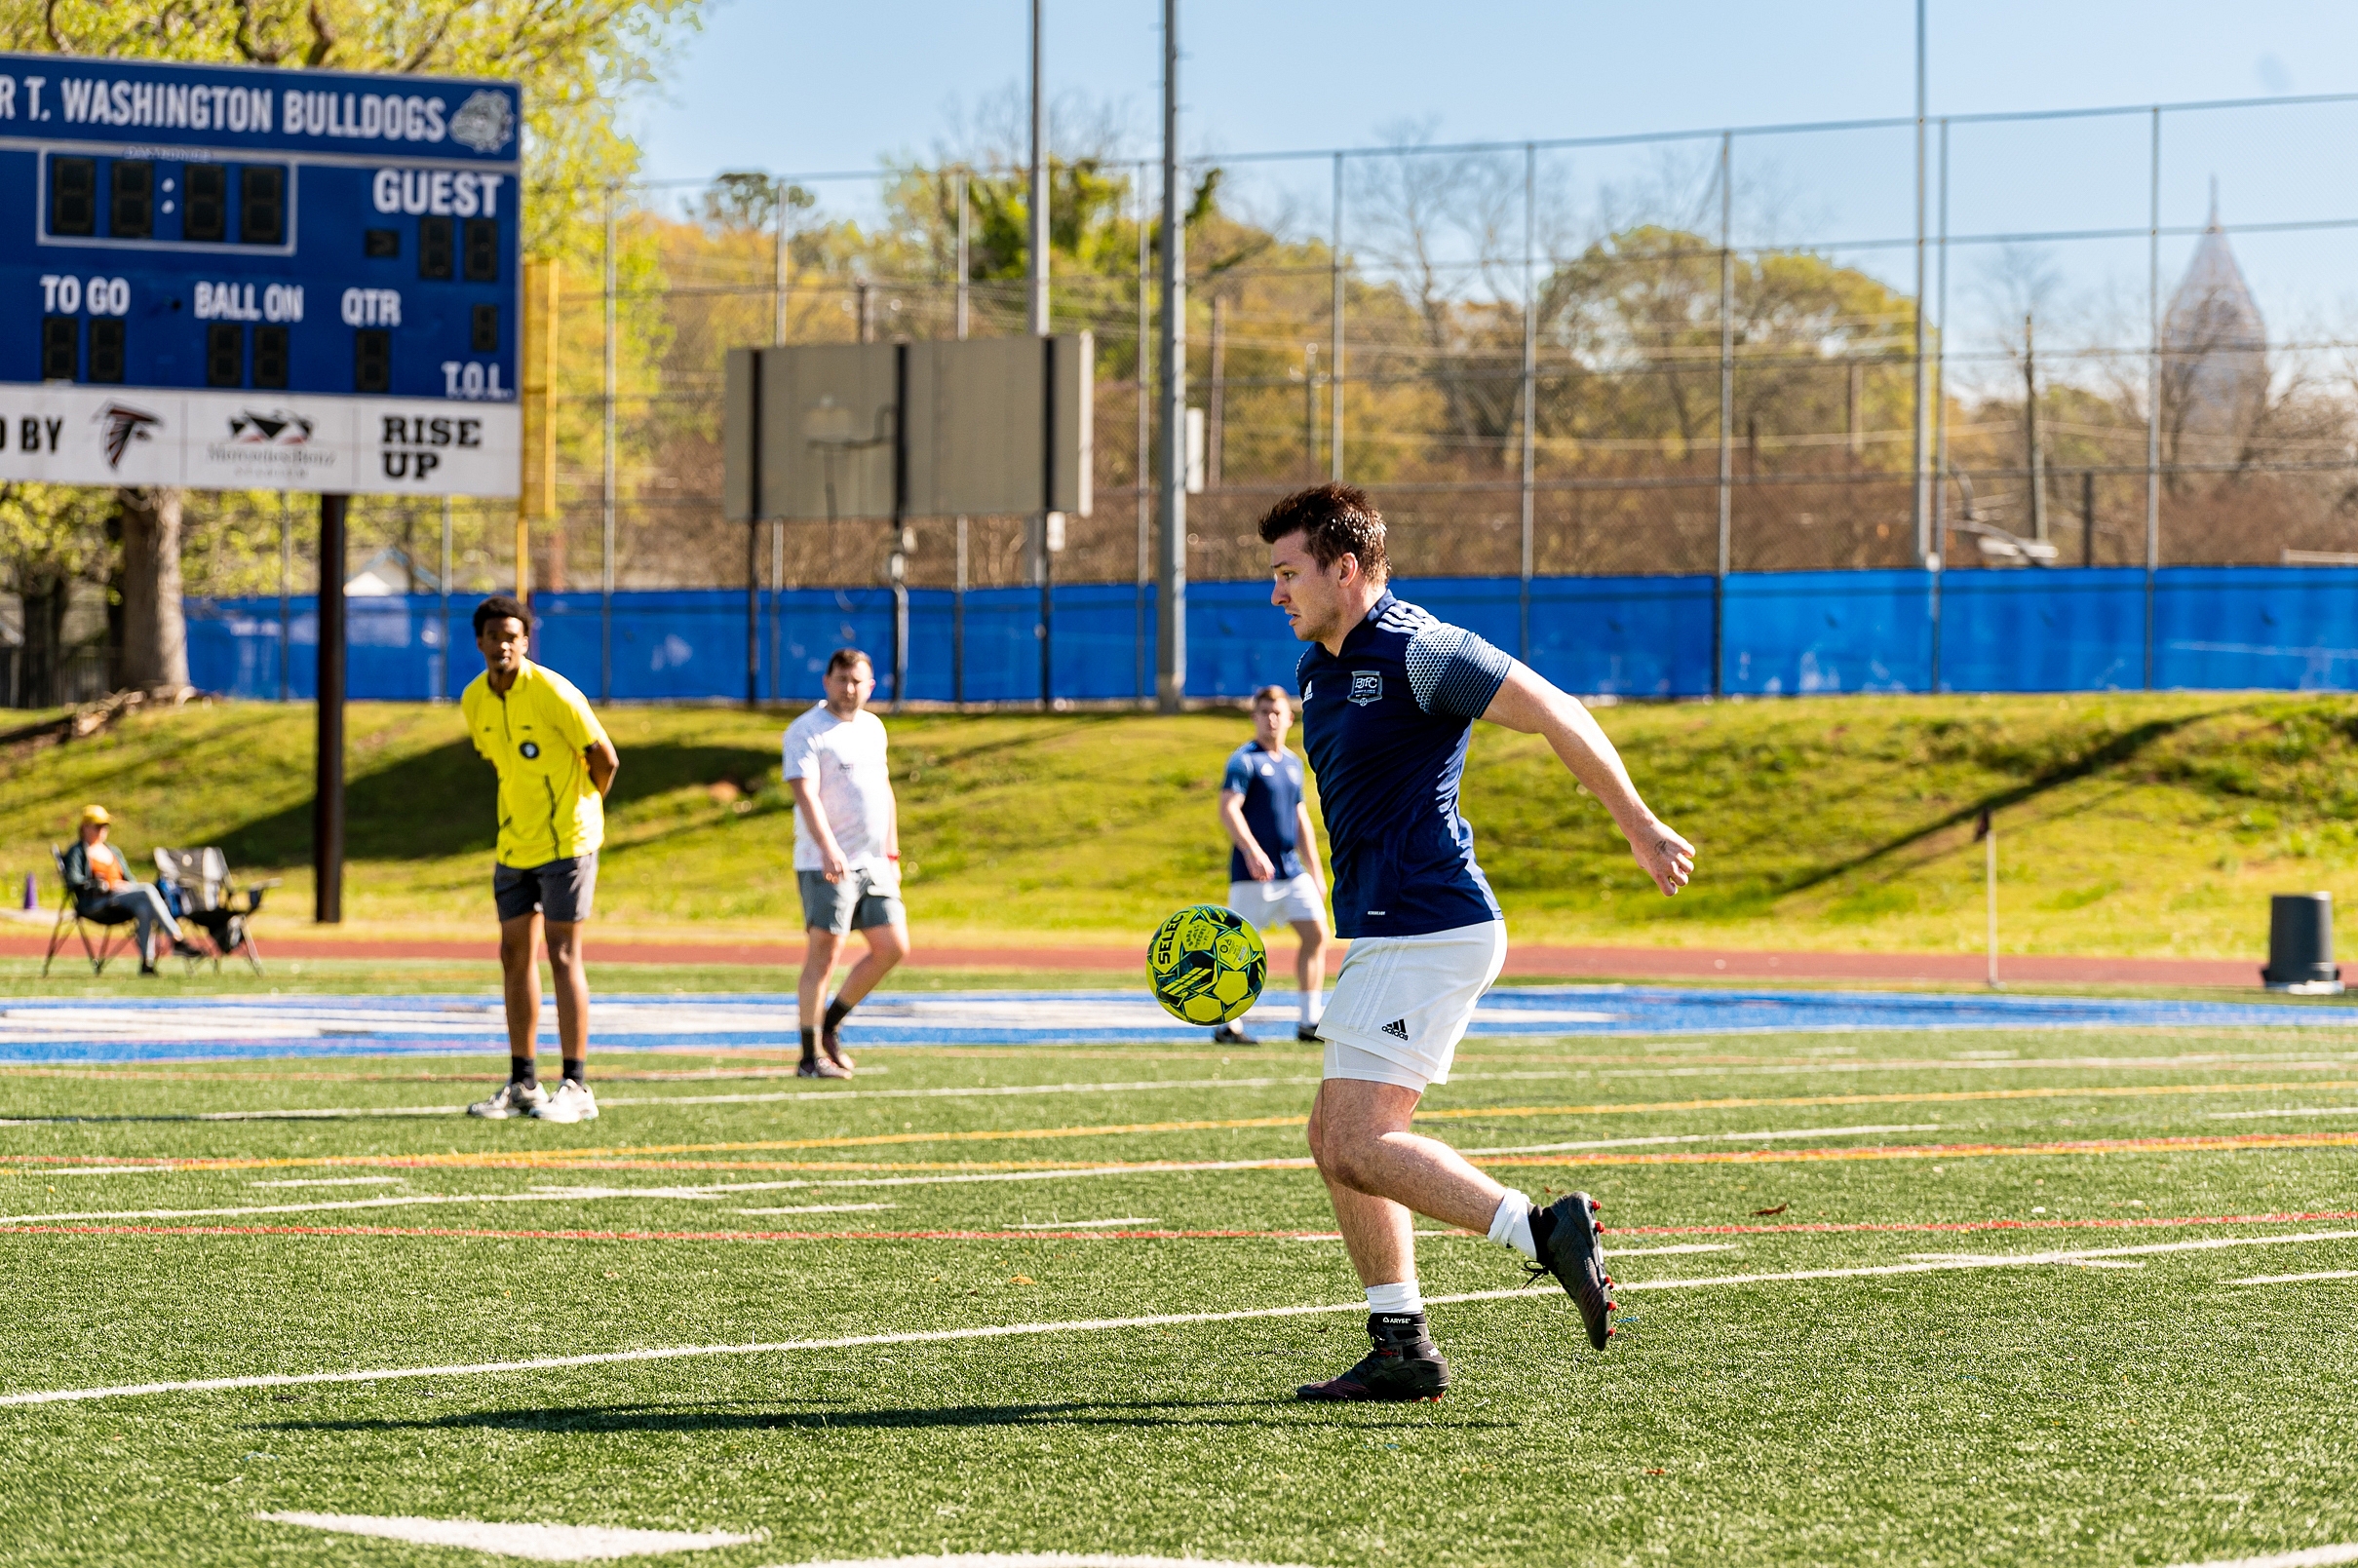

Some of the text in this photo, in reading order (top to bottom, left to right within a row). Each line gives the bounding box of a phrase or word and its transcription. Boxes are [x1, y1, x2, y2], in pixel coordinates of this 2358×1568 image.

[23, 76, 51, 122] T.
[60, 77, 274, 134] WASHINGTON
[282, 89, 446, 143] BULLDOGS
[372, 169, 504, 217] GUEST
[39, 274, 131, 316] TO GO
[194, 281, 304, 323] BALL ON
[341, 287, 402, 327] QTR
[21, 416, 62, 453] BY
[383, 415, 481, 448] RISE
[383, 451, 439, 479] UP
[1381, 1025, 1409, 1041] adidas
